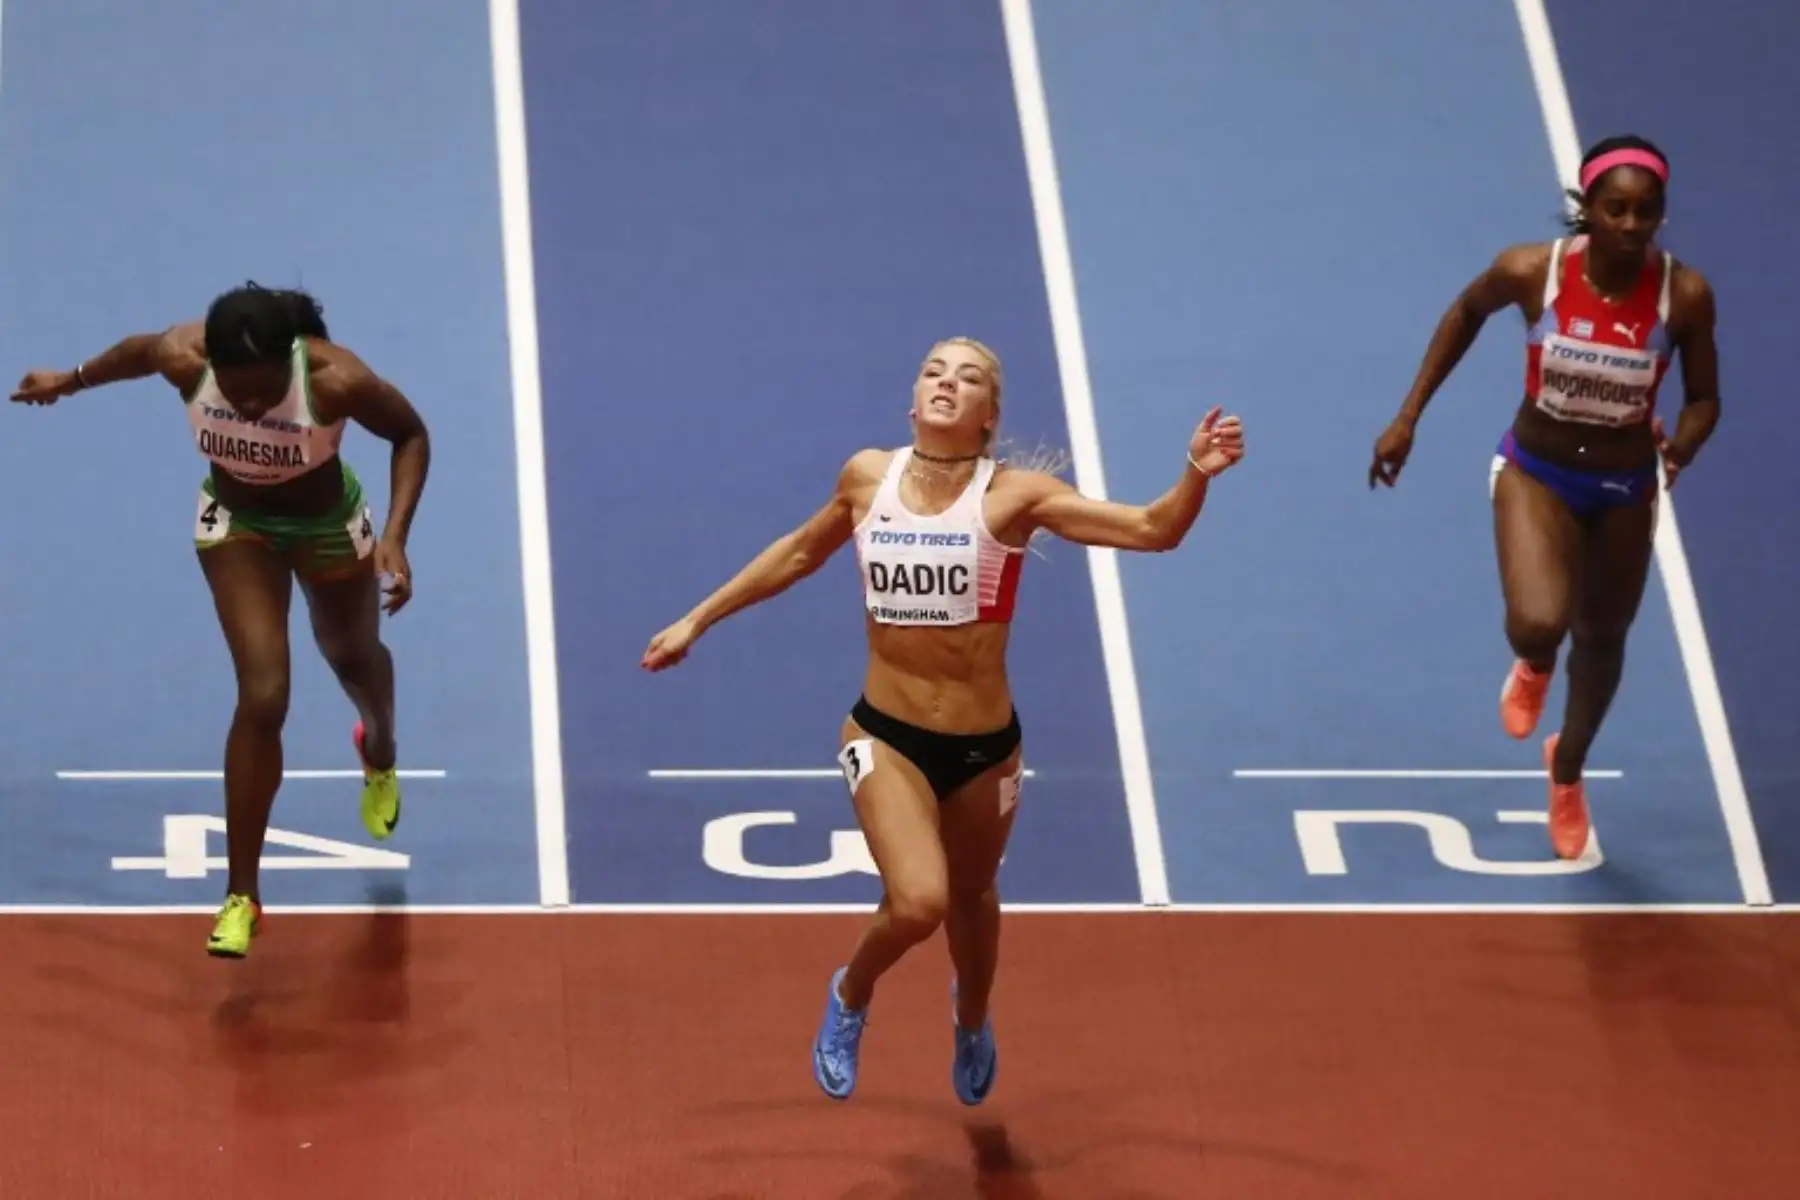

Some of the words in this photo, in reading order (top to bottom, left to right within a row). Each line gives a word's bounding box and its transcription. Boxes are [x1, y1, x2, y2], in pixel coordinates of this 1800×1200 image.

[1551, 344, 1598, 363] TOYO
[200, 429, 305, 467] QUARESMA
[200, 500, 219, 532] 4
[870, 531, 917, 545] TOYO
[919, 533, 971, 546] TIRES
[868, 561, 969, 595] DADIC
[847, 747, 861, 779] 3
[111, 814, 411, 878] 4
[1293, 810, 1604, 875] 2
